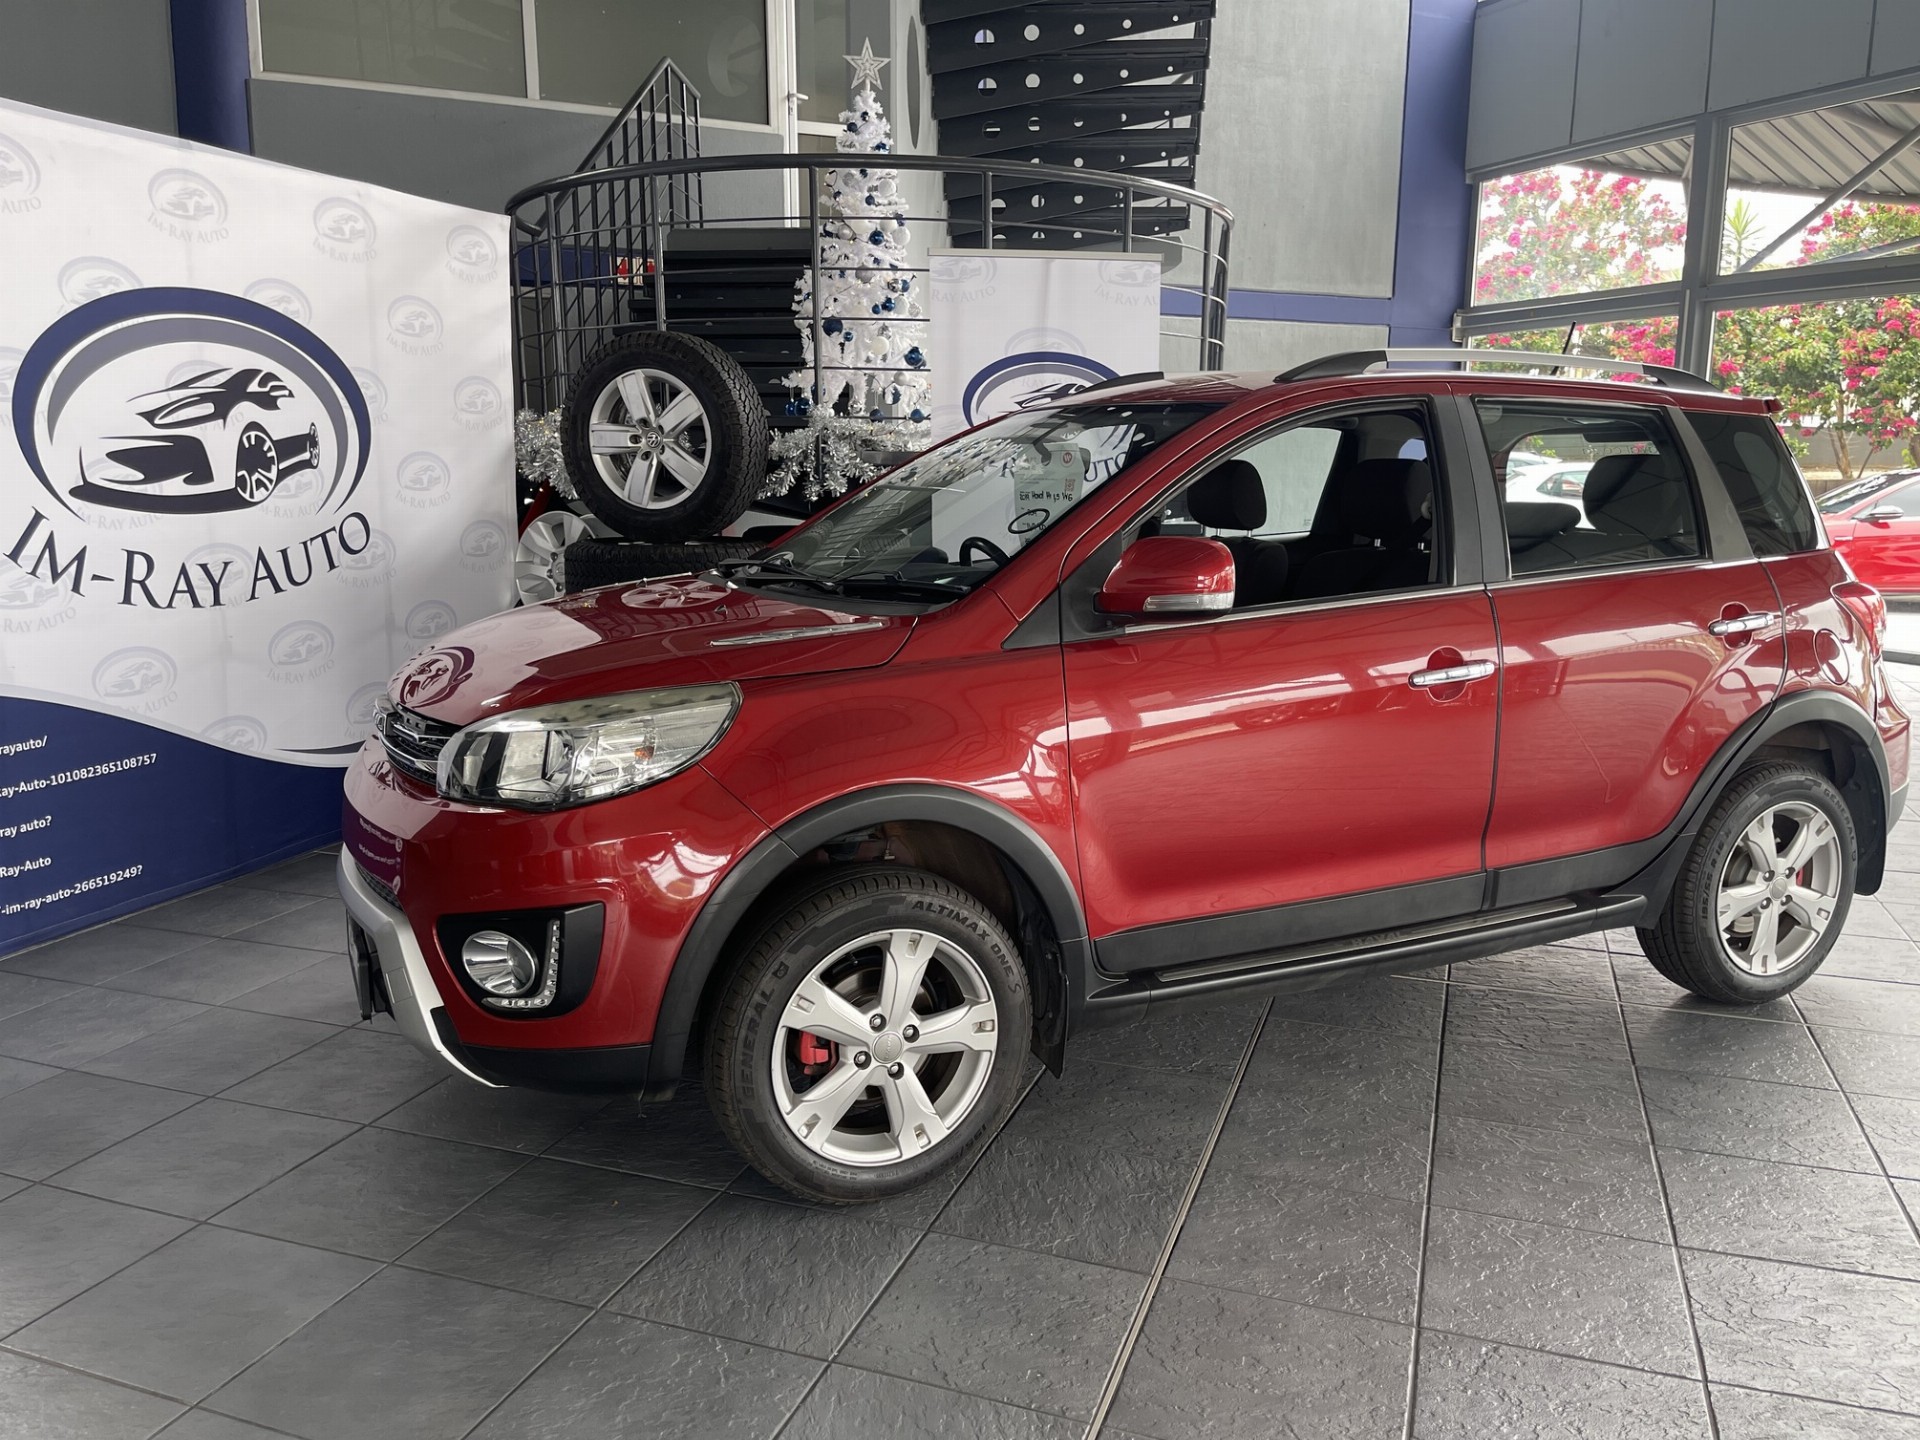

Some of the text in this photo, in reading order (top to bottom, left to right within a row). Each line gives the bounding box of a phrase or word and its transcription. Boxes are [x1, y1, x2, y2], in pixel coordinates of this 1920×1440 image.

[2, 506, 371, 610] IM-RAY AUTO
[20, 815, 52, 833] auto?
[0, 856, 52, 878] Ray-Auto
[0, 864, 143, 915] -im-ray-auto-266519249?
[912, 900, 1022, 994] ALTIMAX ONE S
[739, 980, 776, 1094] GENERAL
